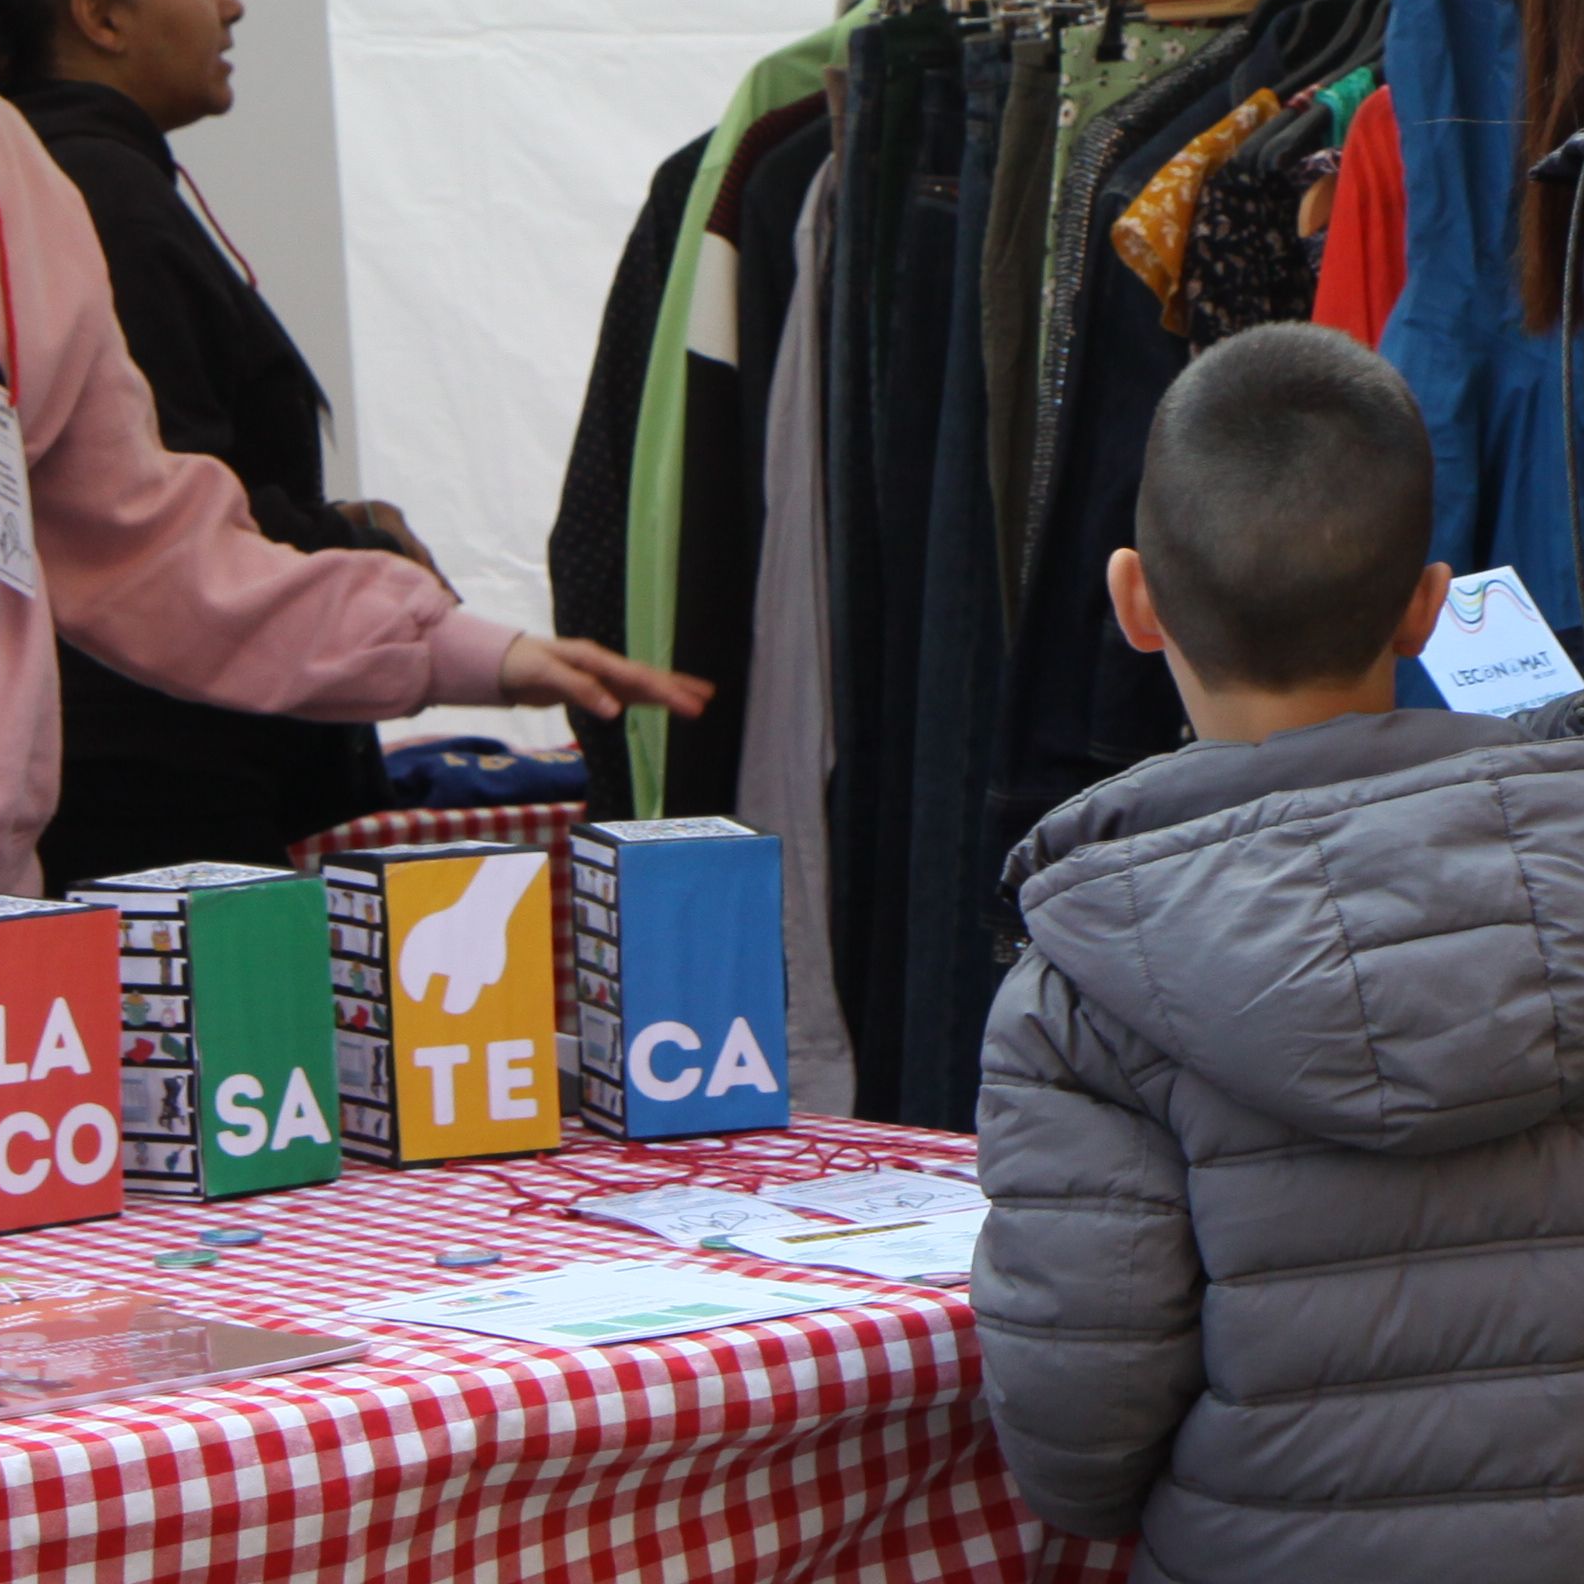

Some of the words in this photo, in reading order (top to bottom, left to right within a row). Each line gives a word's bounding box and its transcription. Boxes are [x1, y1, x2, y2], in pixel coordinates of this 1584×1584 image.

[412, 1038, 538, 1127] TE
[628, 1016, 779, 1102] CA
[215, 1066, 333, 1157] SA
